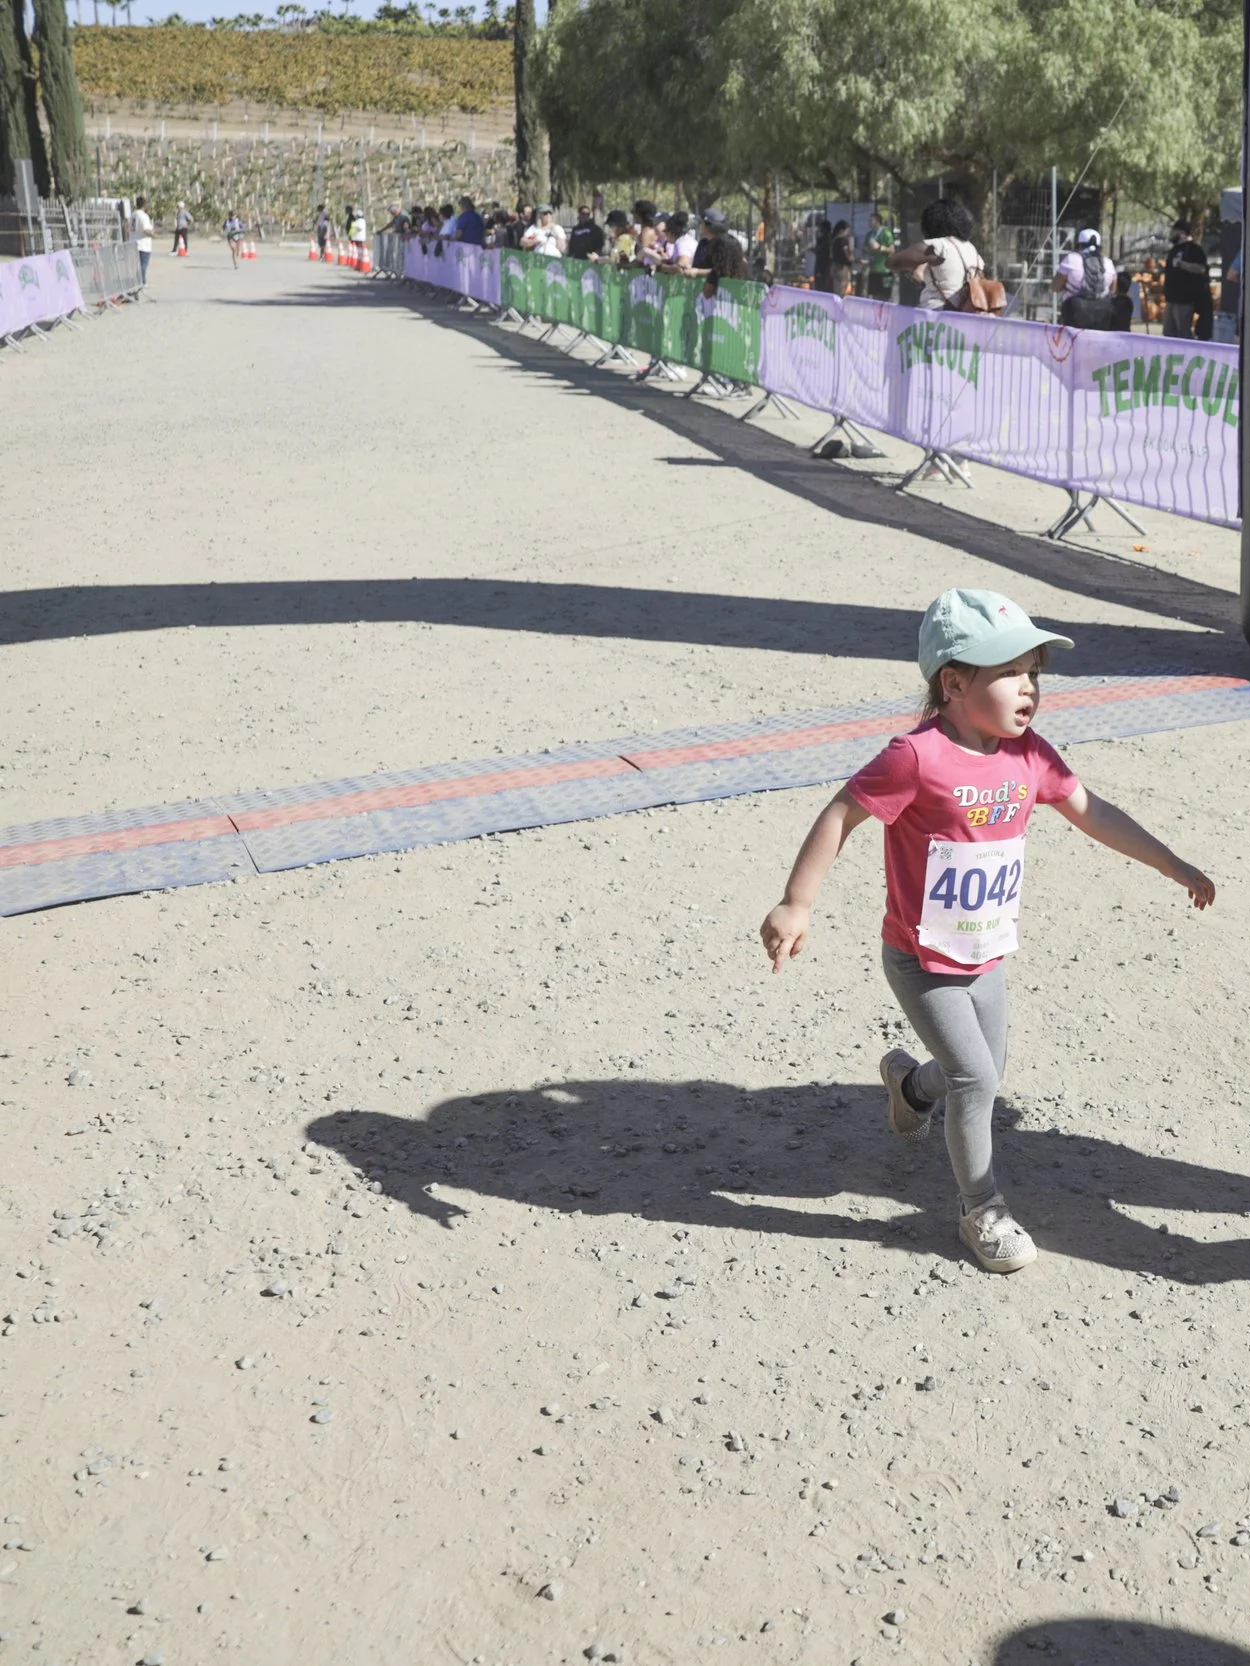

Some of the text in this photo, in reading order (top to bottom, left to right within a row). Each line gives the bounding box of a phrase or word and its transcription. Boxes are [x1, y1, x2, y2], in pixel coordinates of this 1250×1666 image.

[896, 321, 980, 391] TEMECULA
[953, 780, 1029, 807] Dad's
[967, 803, 1020, 827] BFF
[929, 859, 1021, 911] 4042
[957, 920, 983, 932] KIDS
